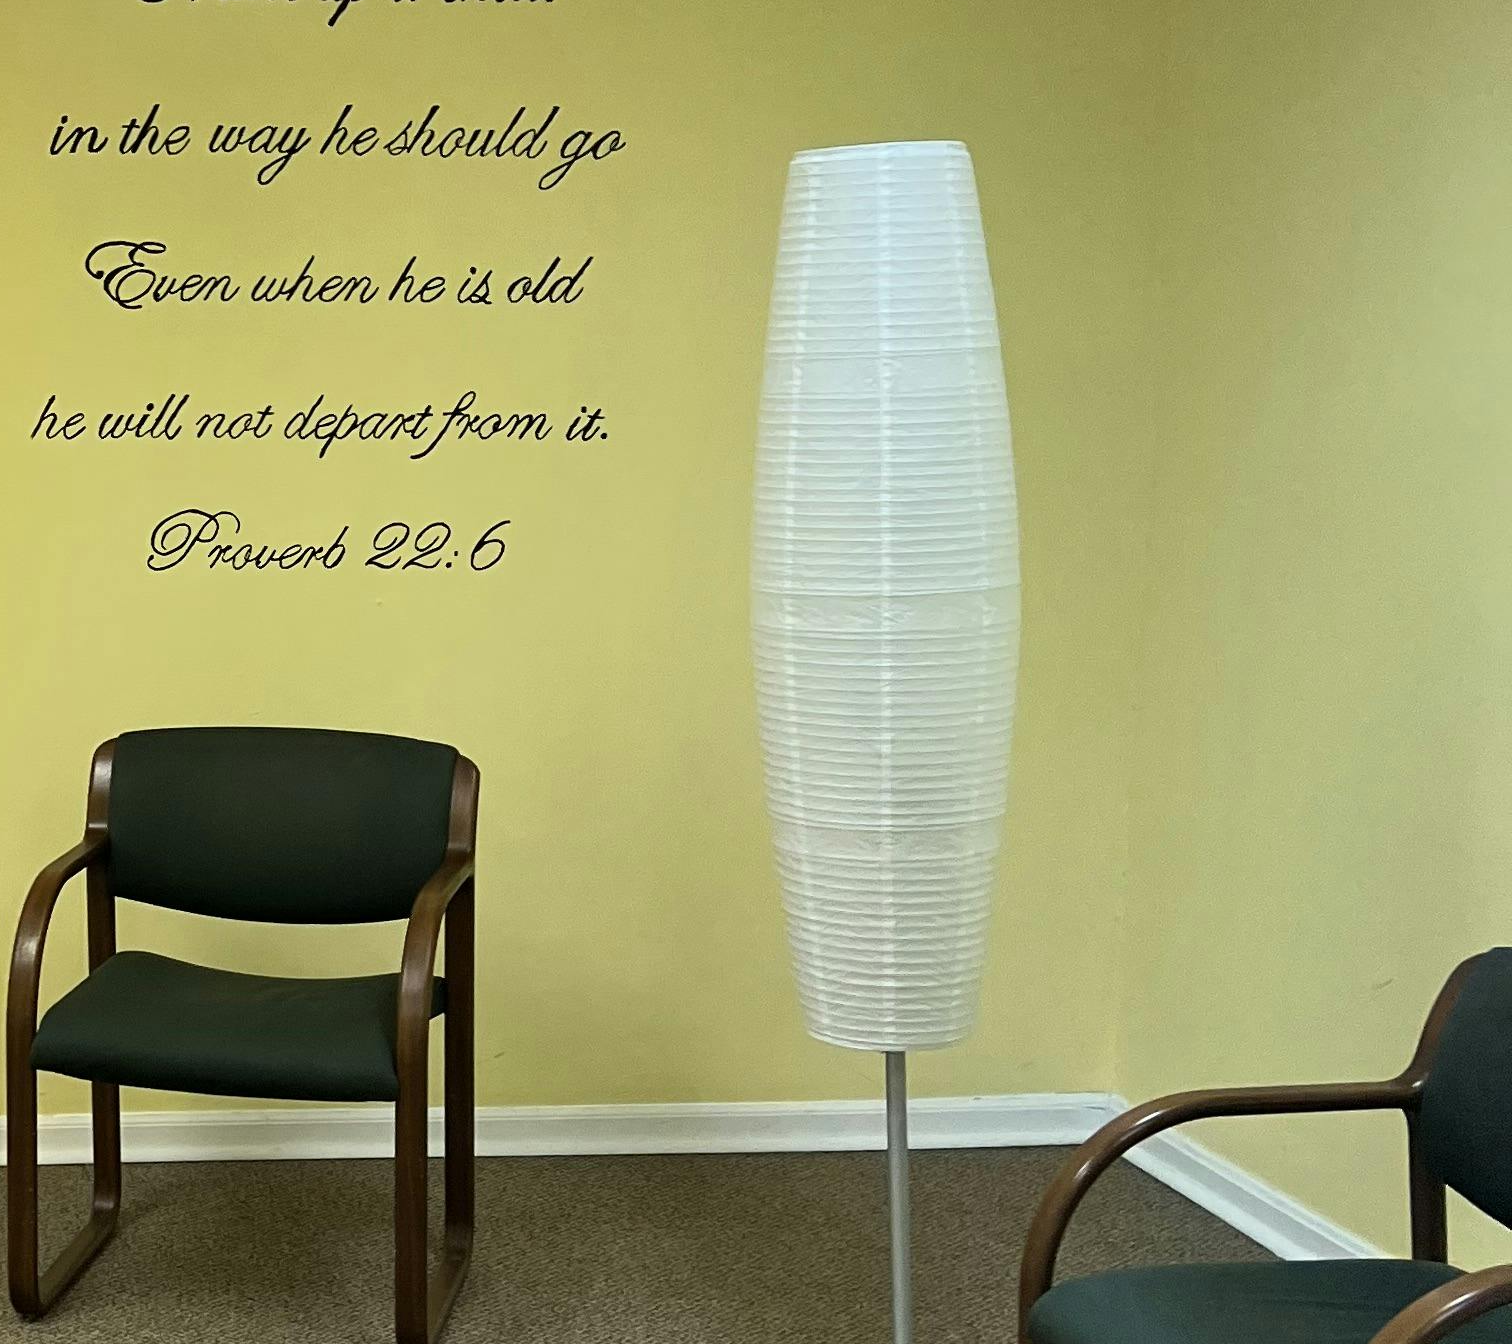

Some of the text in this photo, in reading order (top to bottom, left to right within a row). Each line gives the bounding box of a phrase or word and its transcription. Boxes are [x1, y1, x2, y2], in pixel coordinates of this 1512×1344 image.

[49, 103, 627, 191] in the way he should go
[84, 240, 594, 310] Even when he is old
[30, 390, 608, 460] he will not depart from it.
[146, 508, 511, 572] Proverb 22:6
